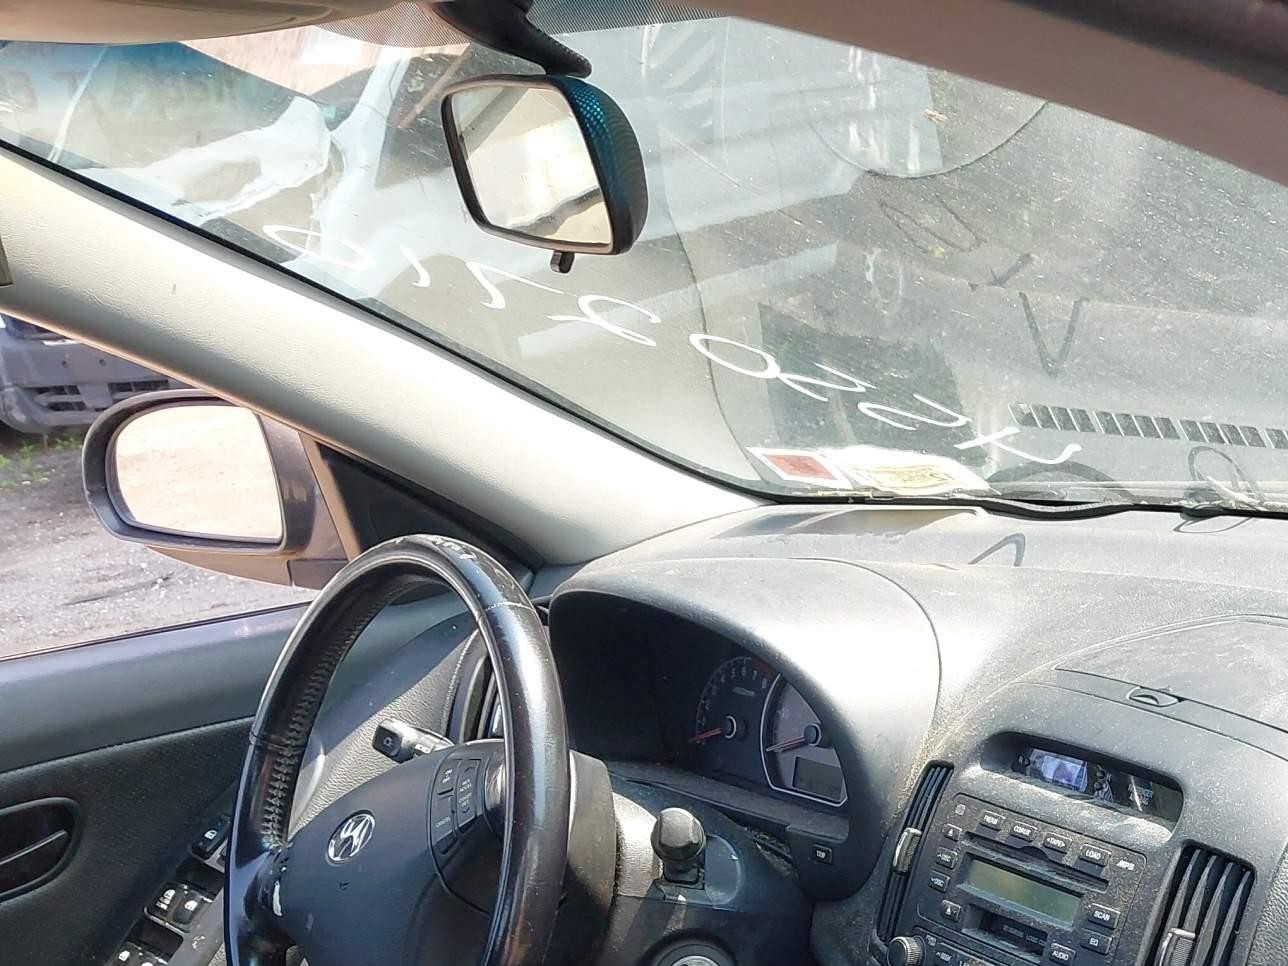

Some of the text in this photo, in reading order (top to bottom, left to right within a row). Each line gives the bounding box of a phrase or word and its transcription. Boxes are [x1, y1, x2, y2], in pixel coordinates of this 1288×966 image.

[1085, 849, 1101, 861] LOAD
[1093, 910, 1111, 922] SCAN
[1089, 938, 1099, 947] EQ
[1052, 950, 1069, 961] AUDIO
